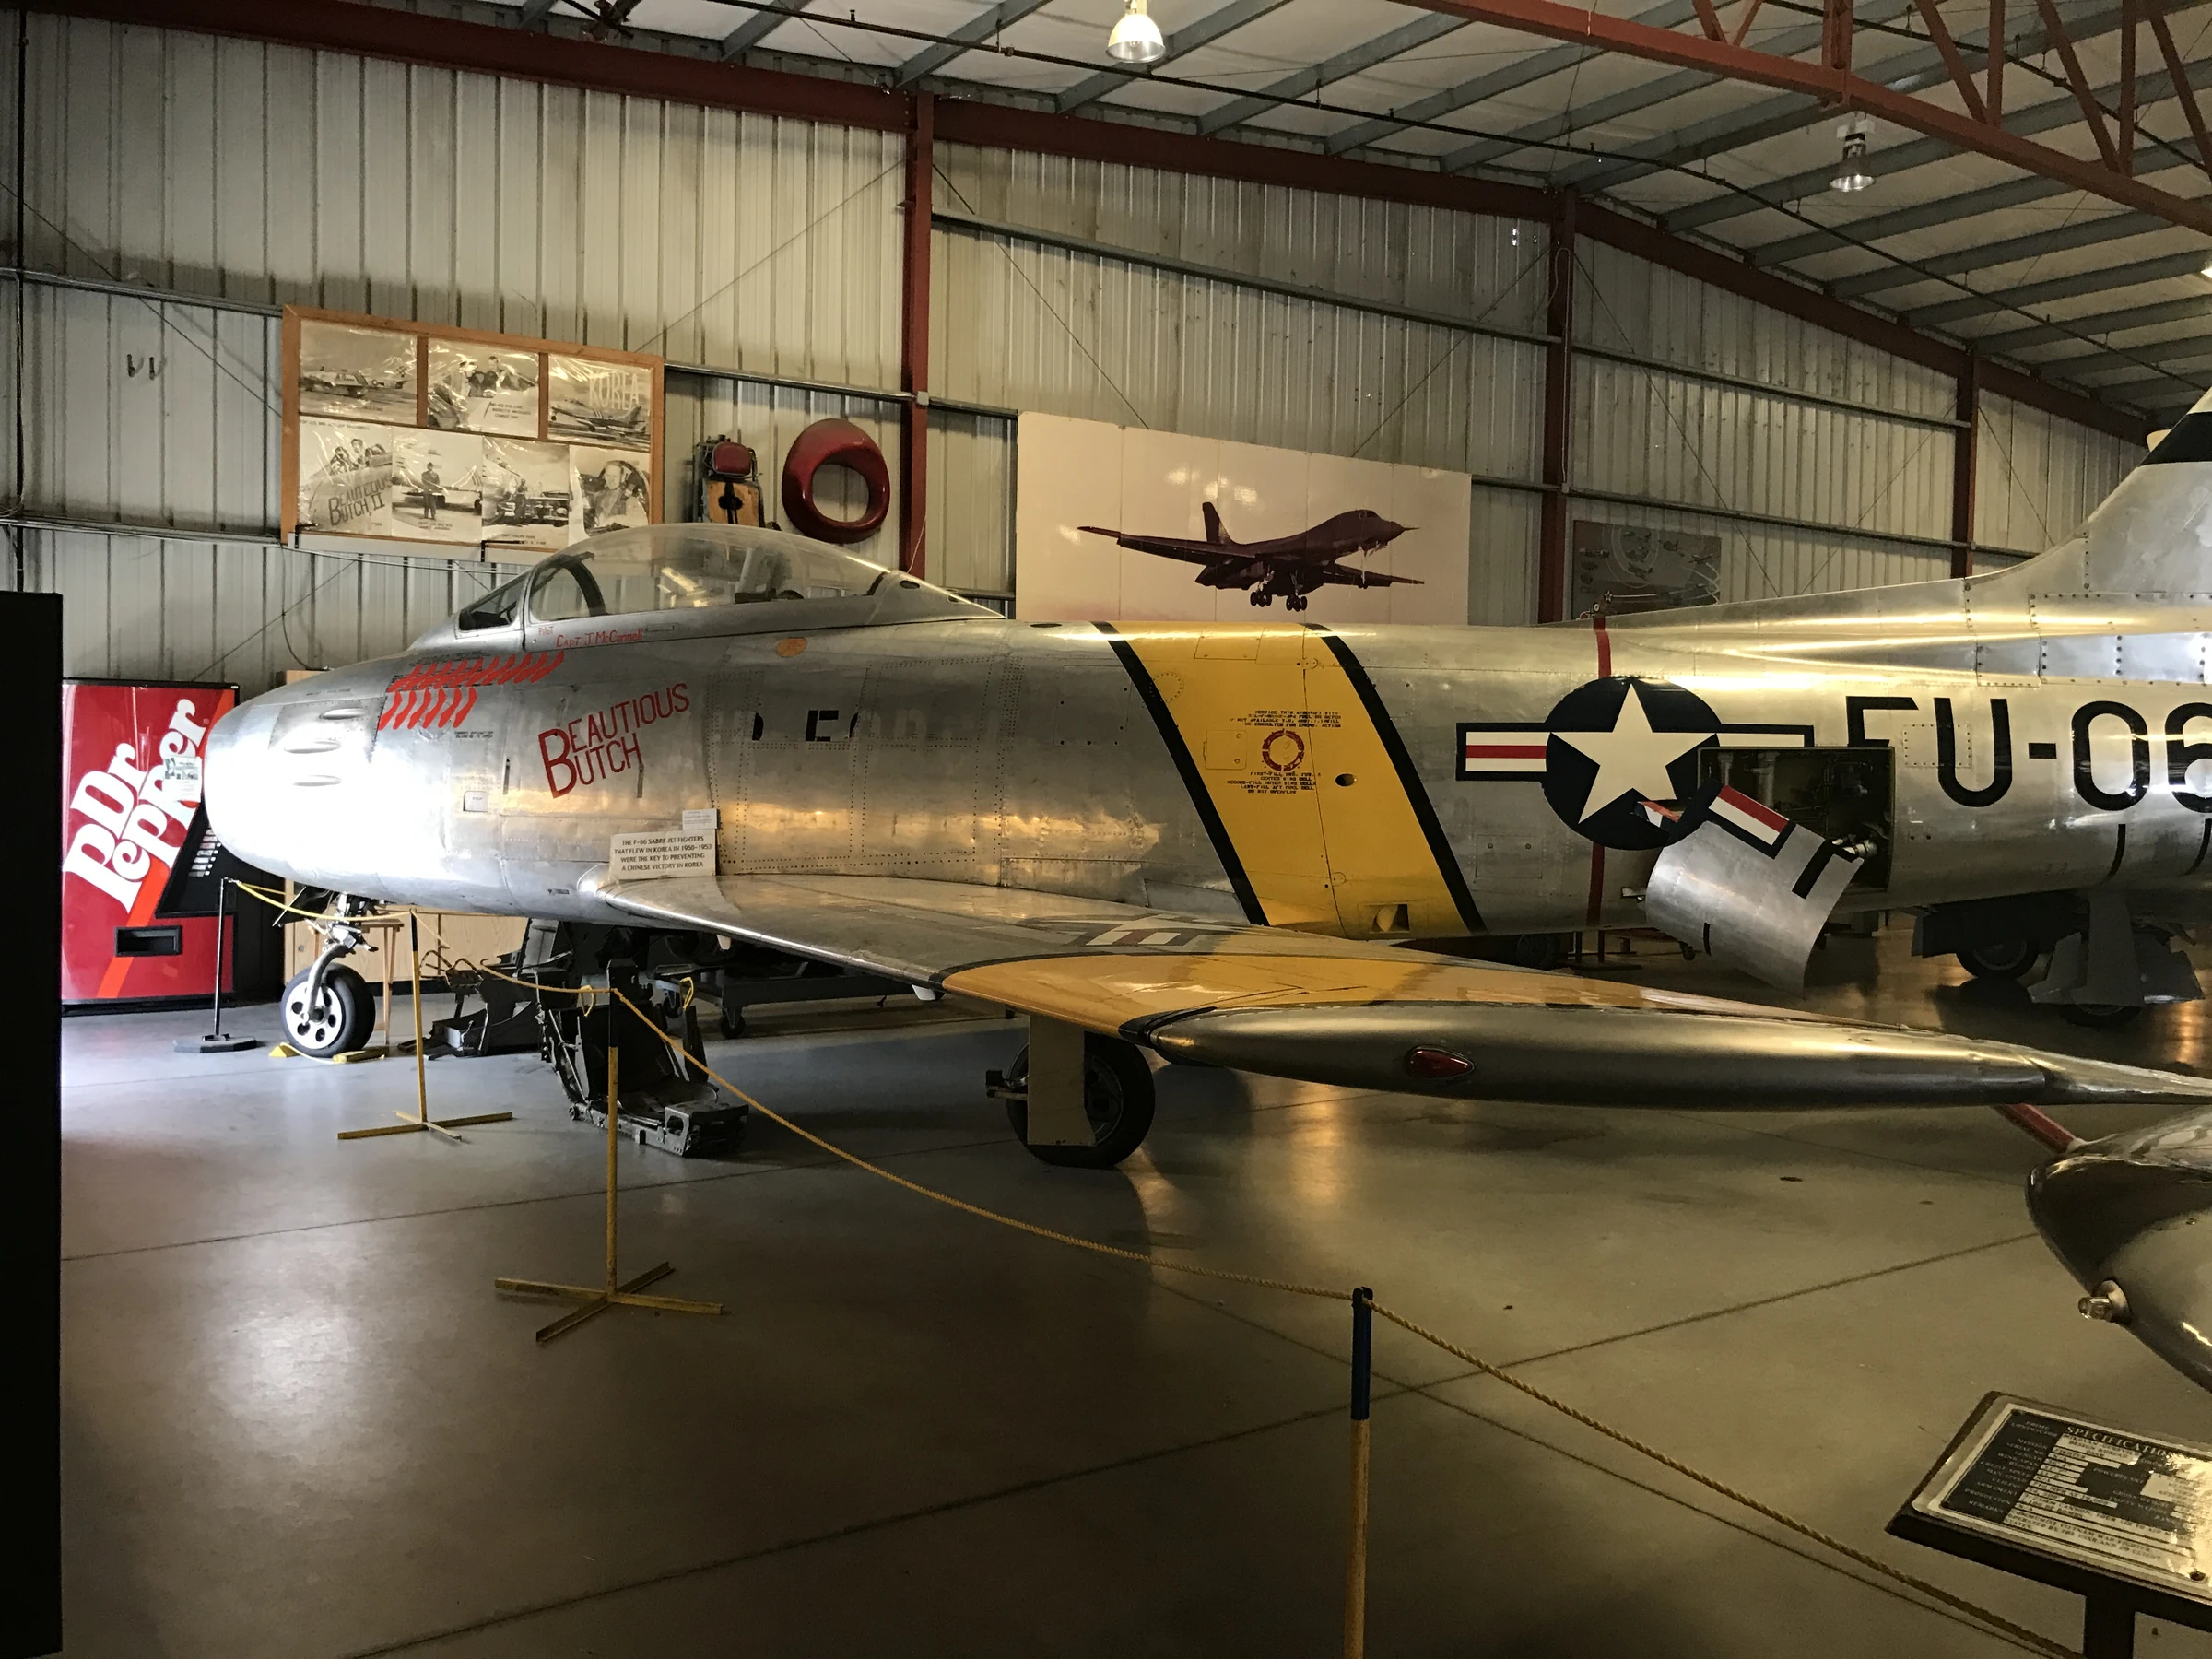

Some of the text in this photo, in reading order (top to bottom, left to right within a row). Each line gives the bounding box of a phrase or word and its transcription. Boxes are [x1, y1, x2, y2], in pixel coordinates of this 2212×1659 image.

[588, 371, 639, 410] KOREA
[595, 628, 643, 644] McConnell
[538, 683, 690, 789] BEAUTIOUS
[70, 743, 147, 840] Dr
